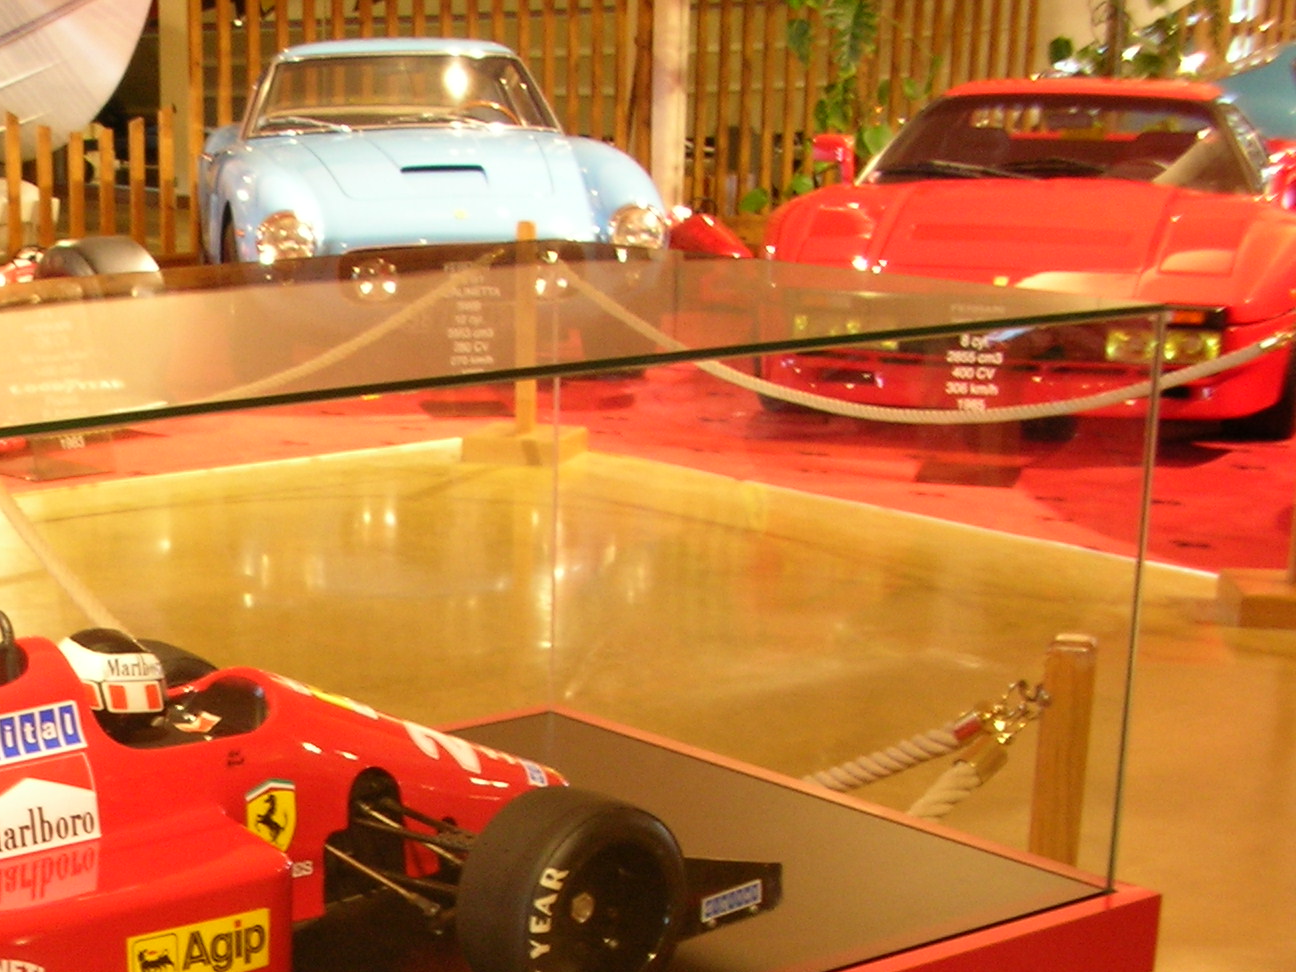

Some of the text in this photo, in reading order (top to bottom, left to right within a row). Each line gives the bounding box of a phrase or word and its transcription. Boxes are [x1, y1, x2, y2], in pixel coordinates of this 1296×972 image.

[951, 366, 996, 380] 400 CV
[182, 919, 266, 972] Agip
